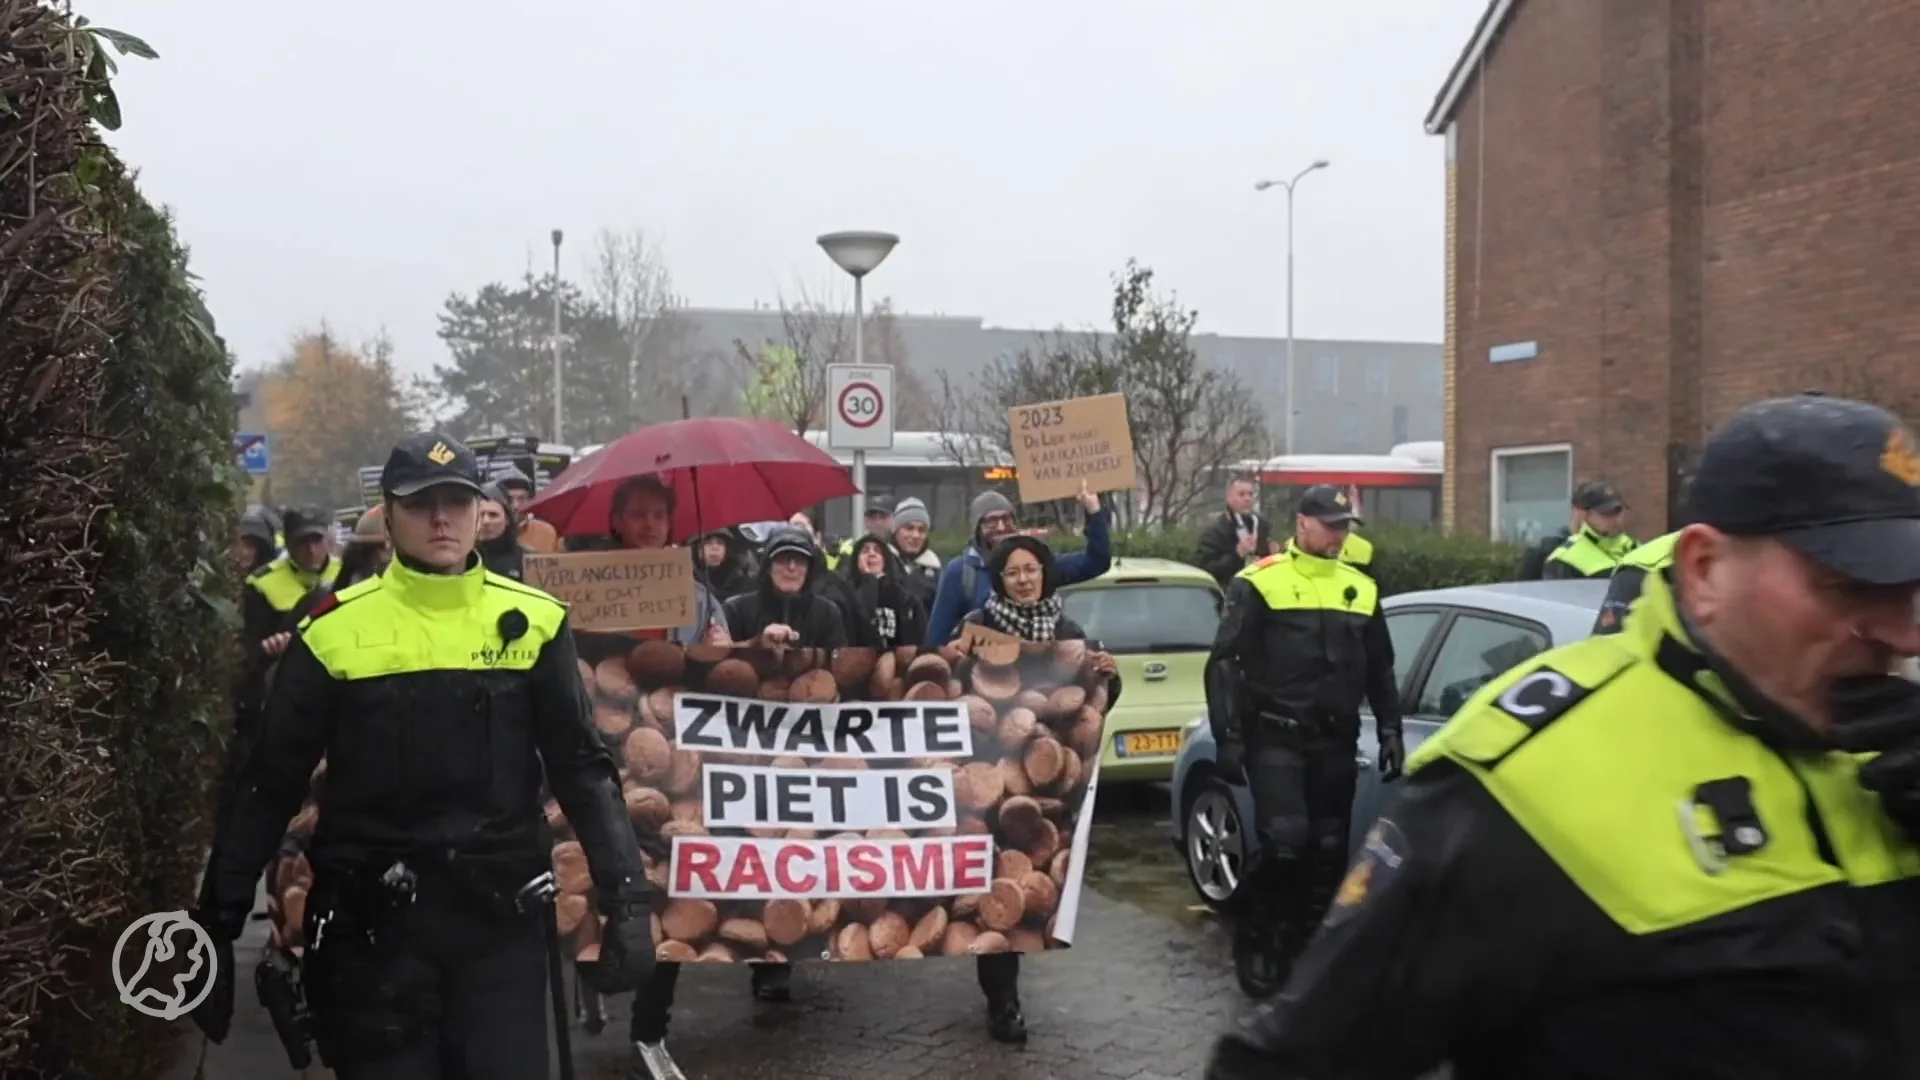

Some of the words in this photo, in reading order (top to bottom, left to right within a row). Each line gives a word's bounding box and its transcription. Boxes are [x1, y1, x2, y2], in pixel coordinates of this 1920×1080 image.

[847, 395, 876, 416] 30
[1019, 406, 1064, 430] 2023
[1033, 464, 1062, 480] VAN
[1499, 671, 1572, 716] C
[681, 697, 964, 753] ZWARTE
[709, 770, 858, 823] PIET
[884, 774, 949, 823] IS
[675, 840, 988, 894] RACISME
